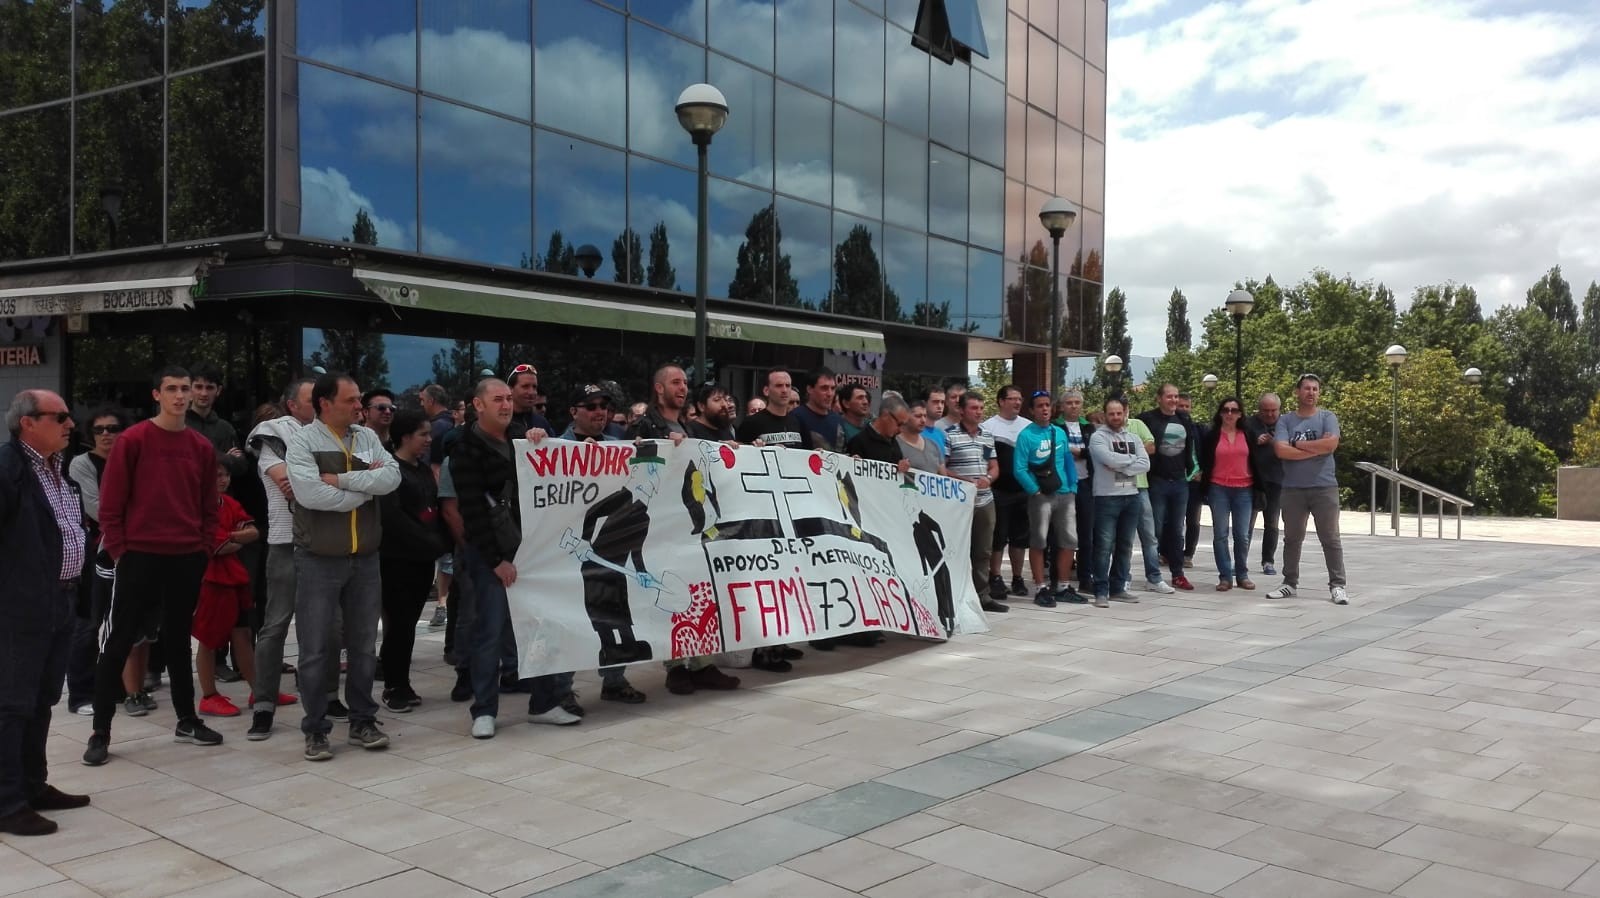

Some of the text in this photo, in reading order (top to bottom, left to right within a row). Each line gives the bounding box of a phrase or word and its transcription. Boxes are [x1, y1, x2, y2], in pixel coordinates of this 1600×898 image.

[103, 289, 174, 309] BOCADILLOS
[835, 373, 881, 389] CAFETERIA
[526, 443, 633, 477] WINDAR
[854, 458, 967, 502] GAMESA SIEMENS
[534, 480, 599, 508] GRUPO
[712, 553, 779, 573] APOYOS
